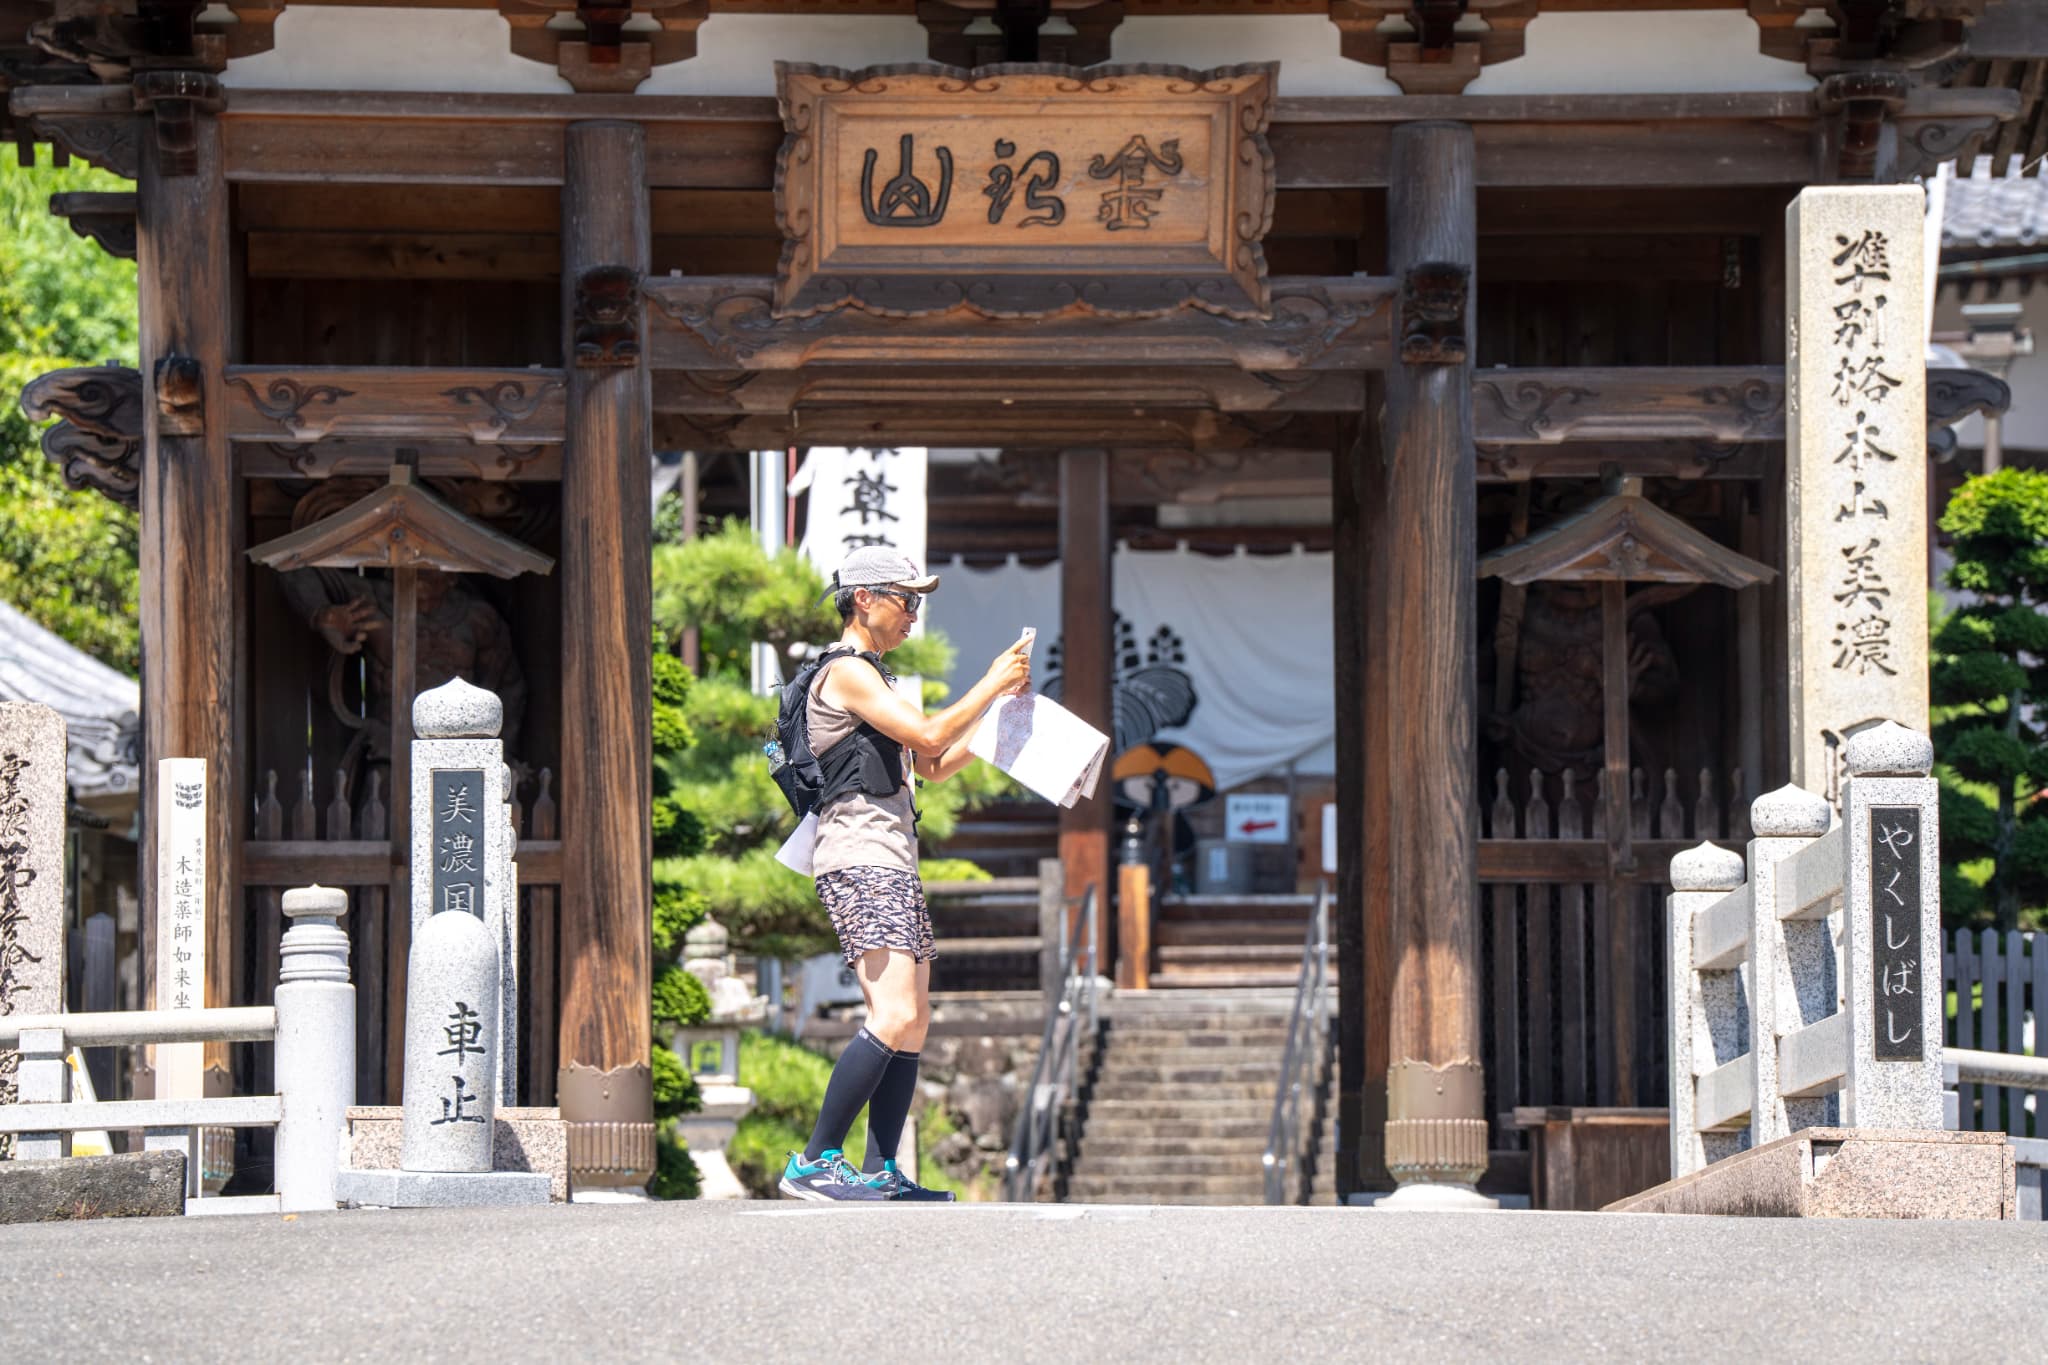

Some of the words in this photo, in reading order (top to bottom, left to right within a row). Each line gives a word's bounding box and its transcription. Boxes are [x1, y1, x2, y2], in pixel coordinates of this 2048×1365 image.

[1877, 822, 1918, 1045] やくしばし
[430, 1001, 487, 1125] 車止
